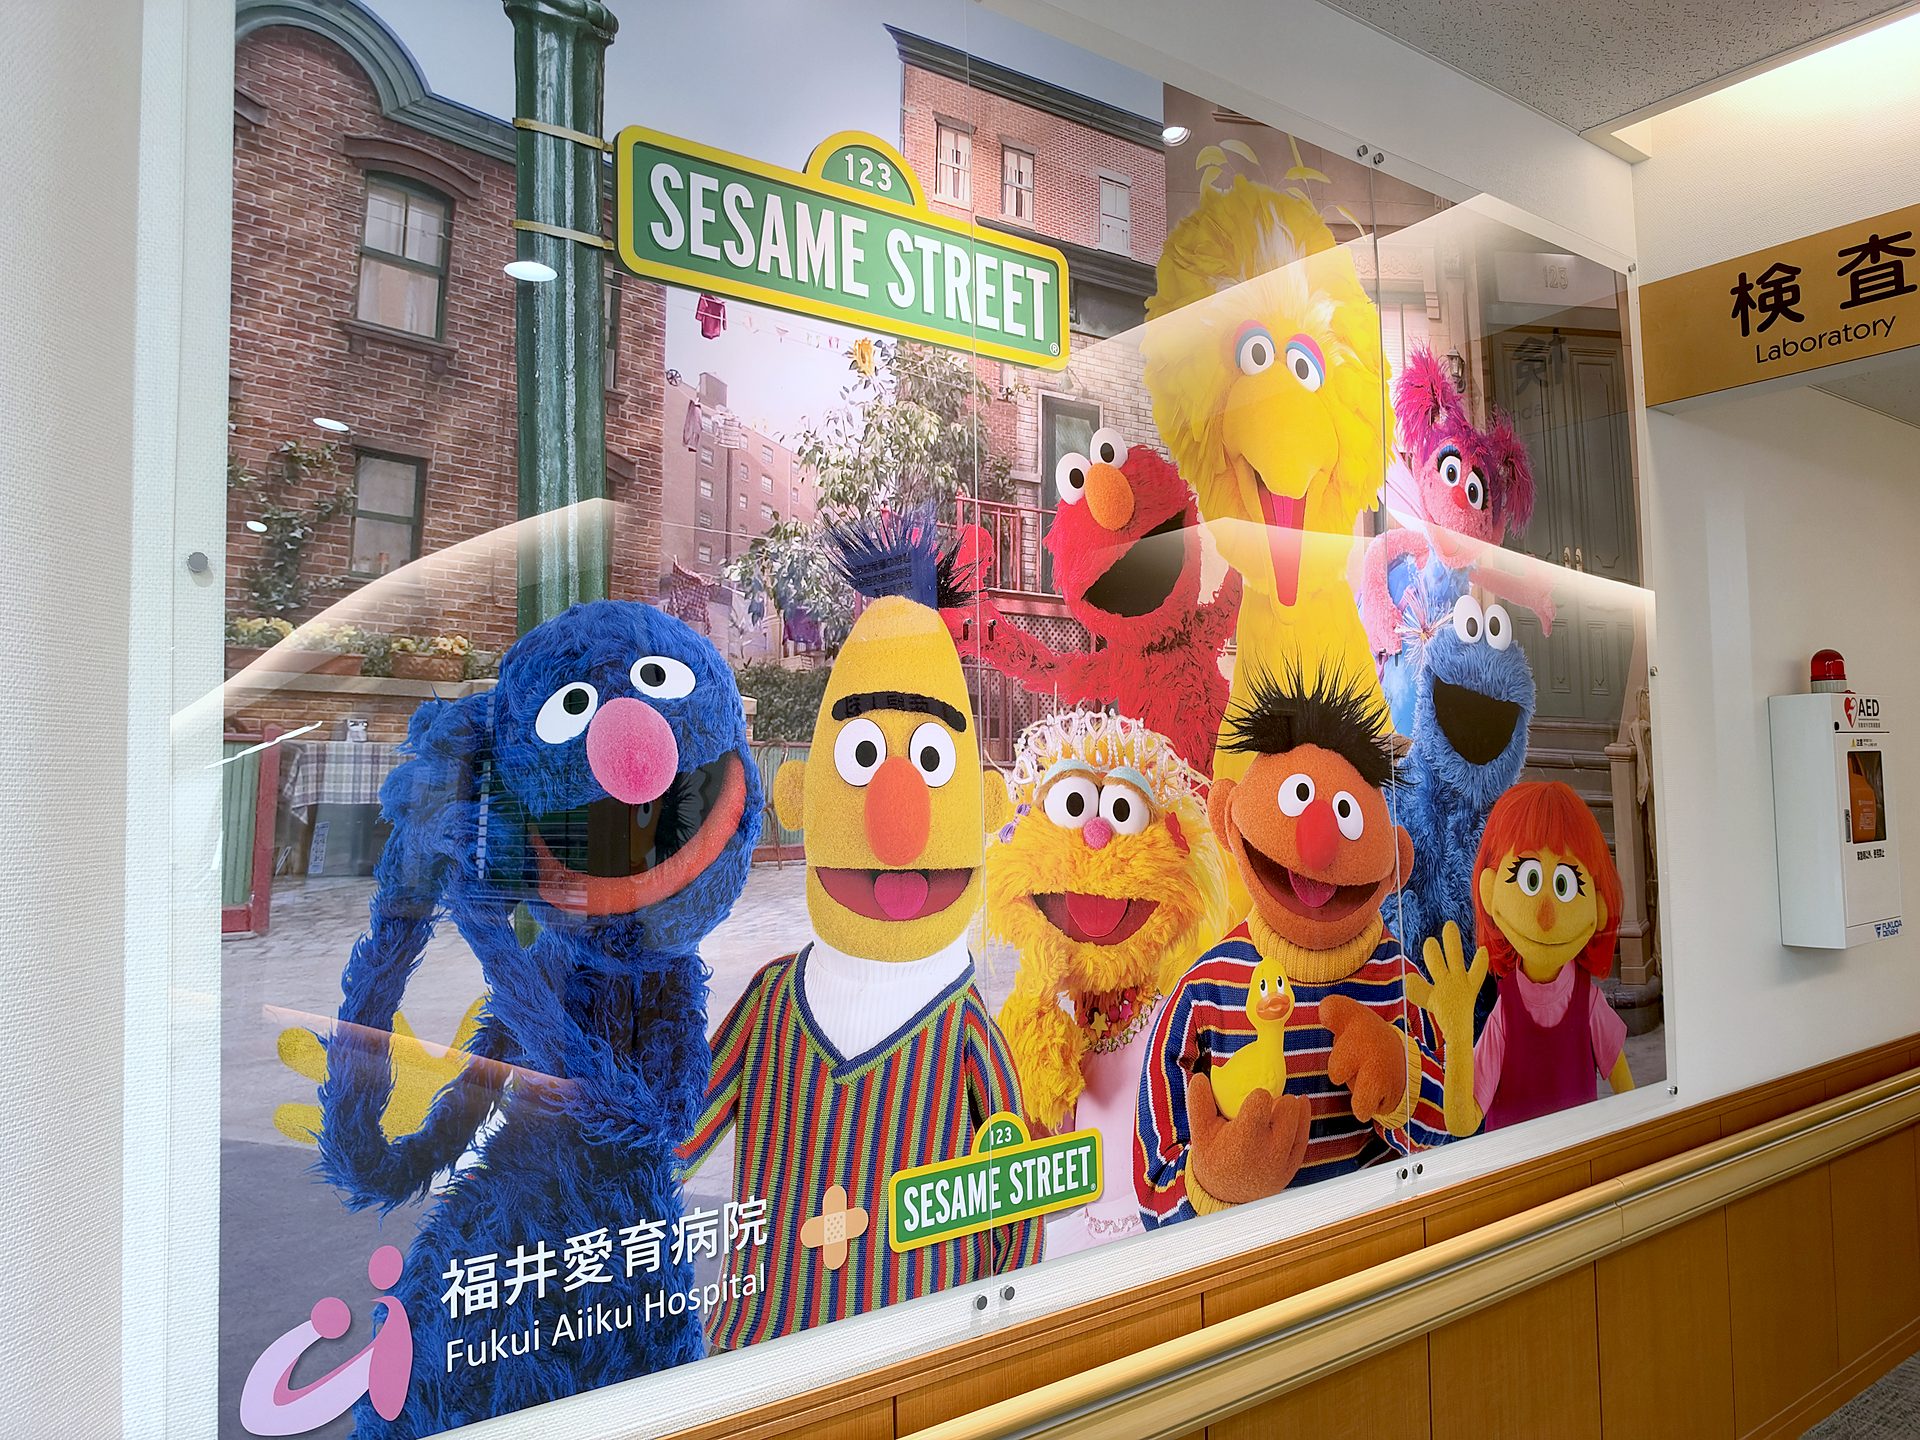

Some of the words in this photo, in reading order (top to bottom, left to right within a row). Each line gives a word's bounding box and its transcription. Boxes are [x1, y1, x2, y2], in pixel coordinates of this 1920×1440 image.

[845, 153, 891, 191] 123
[650, 163, 870, 298] SESAME
[886, 228, 1050, 341] STREET
[1730, 231, 1918, 337] 検査
[1756, 315, 1897, 364] Laboratory
[1858, 699, 1880, 717] AED
[990, 1127, 1012, 1146] 123
[903, 1167, 1001, 1232] SESAME
[1009, 1146, 1091, 1204] STREET
[441, 1195, 768, 1319] 福井愛育病院
[446, 1321, 541, 1373] Fukui
[551, 1303, 632, 1346] Aiiku
[645, 1263, 765, 1322] Hospital
